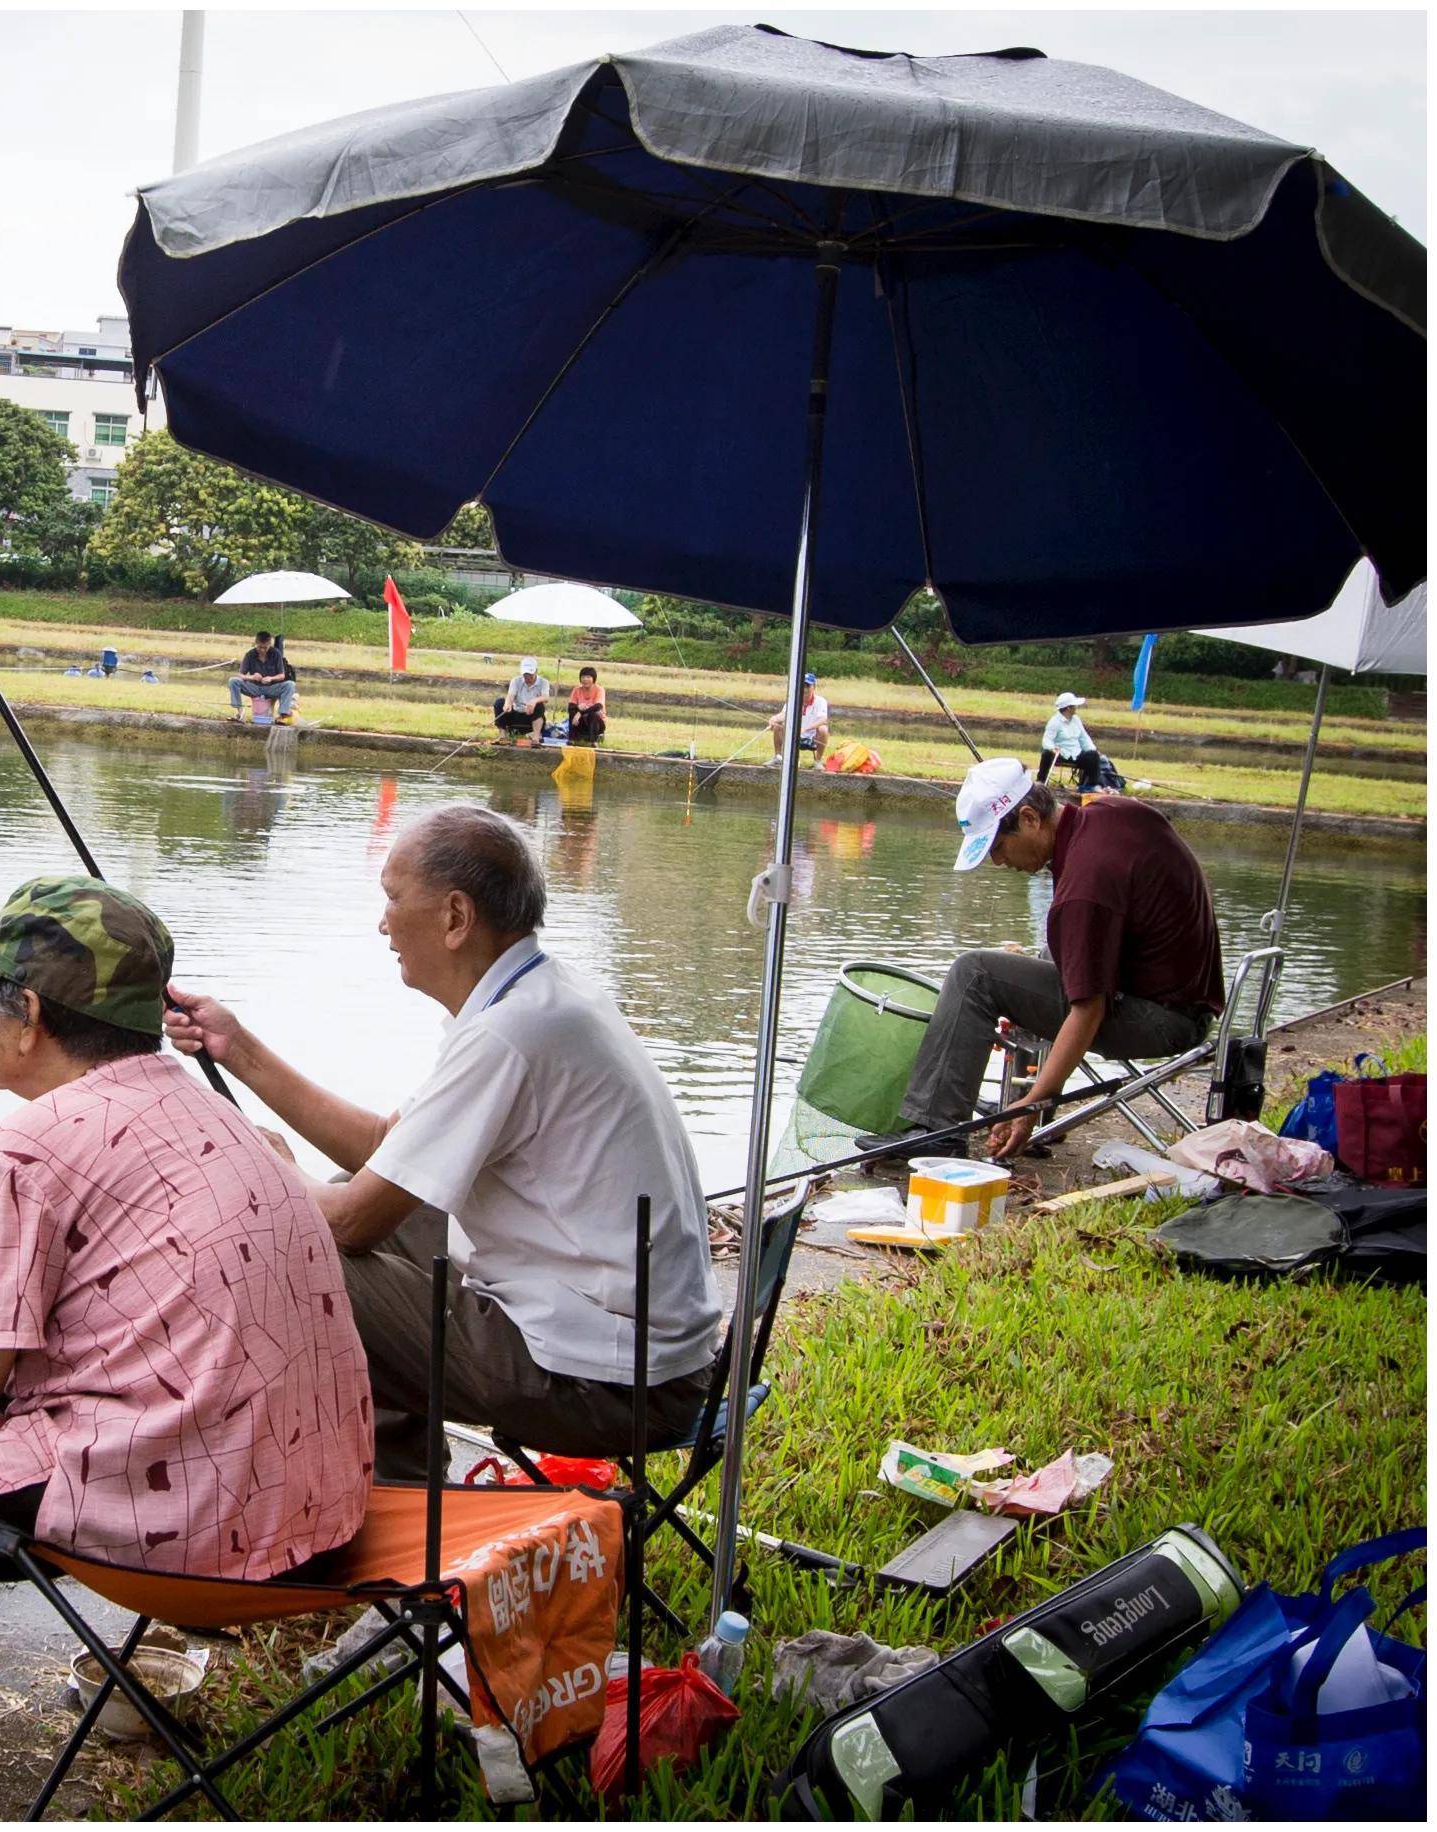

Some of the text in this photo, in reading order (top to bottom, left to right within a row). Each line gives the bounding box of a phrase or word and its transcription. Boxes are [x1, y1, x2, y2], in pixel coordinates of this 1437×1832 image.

[1080, 1584, 1171, 1647] Longteng
[1275, 1751, 1322, 1774] 天问
[1149, 1782, 1198, 1822] 湖北
